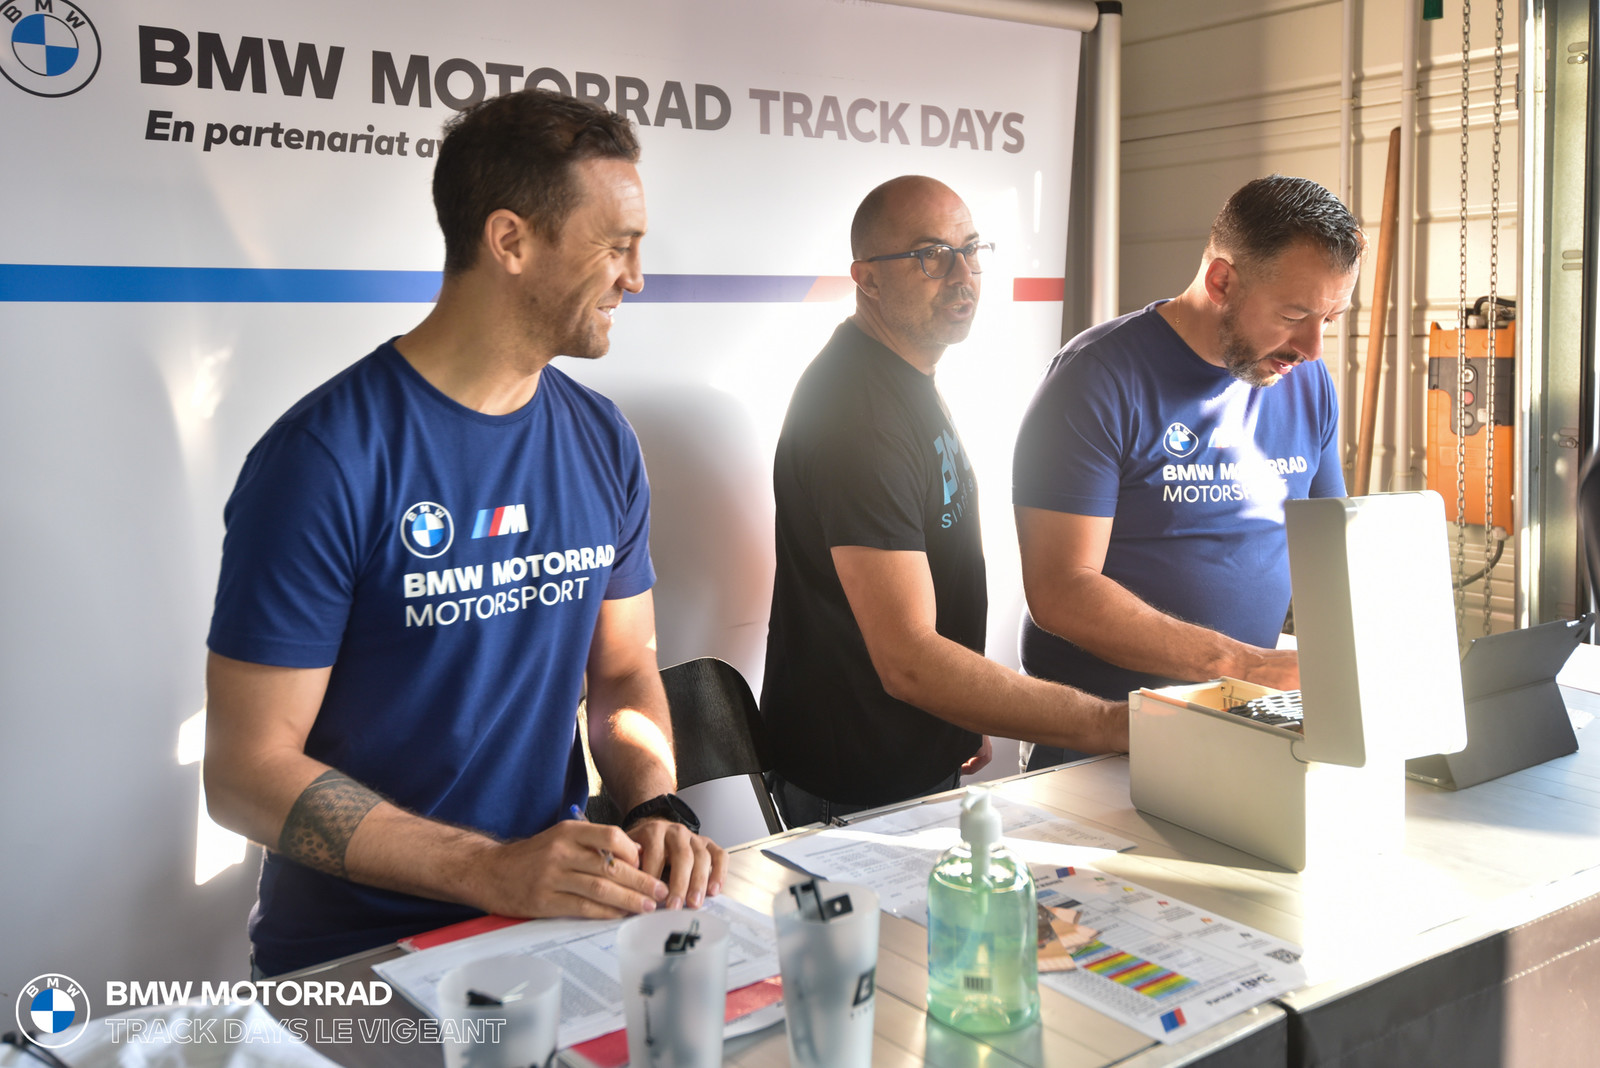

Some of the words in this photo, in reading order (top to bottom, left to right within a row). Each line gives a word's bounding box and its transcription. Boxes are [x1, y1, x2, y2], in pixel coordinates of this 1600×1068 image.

[3, 0, 86, 29] BMW
[138, 25, 345, 100] BMW
[749, 87, 910, 146] TRACK
[920, 104, 1025, 154] DAYS
[145, 109, 195, 142] En
[203, 121, 409, 157] partenariat
[1163, 463, 1214, 481] BMW
[1220, 455, 1308, 481] MRRAD
[1163, 479, 1288, 503] MOTORS
[406, 505, 446, 522] BMW
[403, 564, 484, 598] BMW
[492, 544, 616, 586] MOTORRAD
[405, 577, 590, 627] MOTORSPORT
